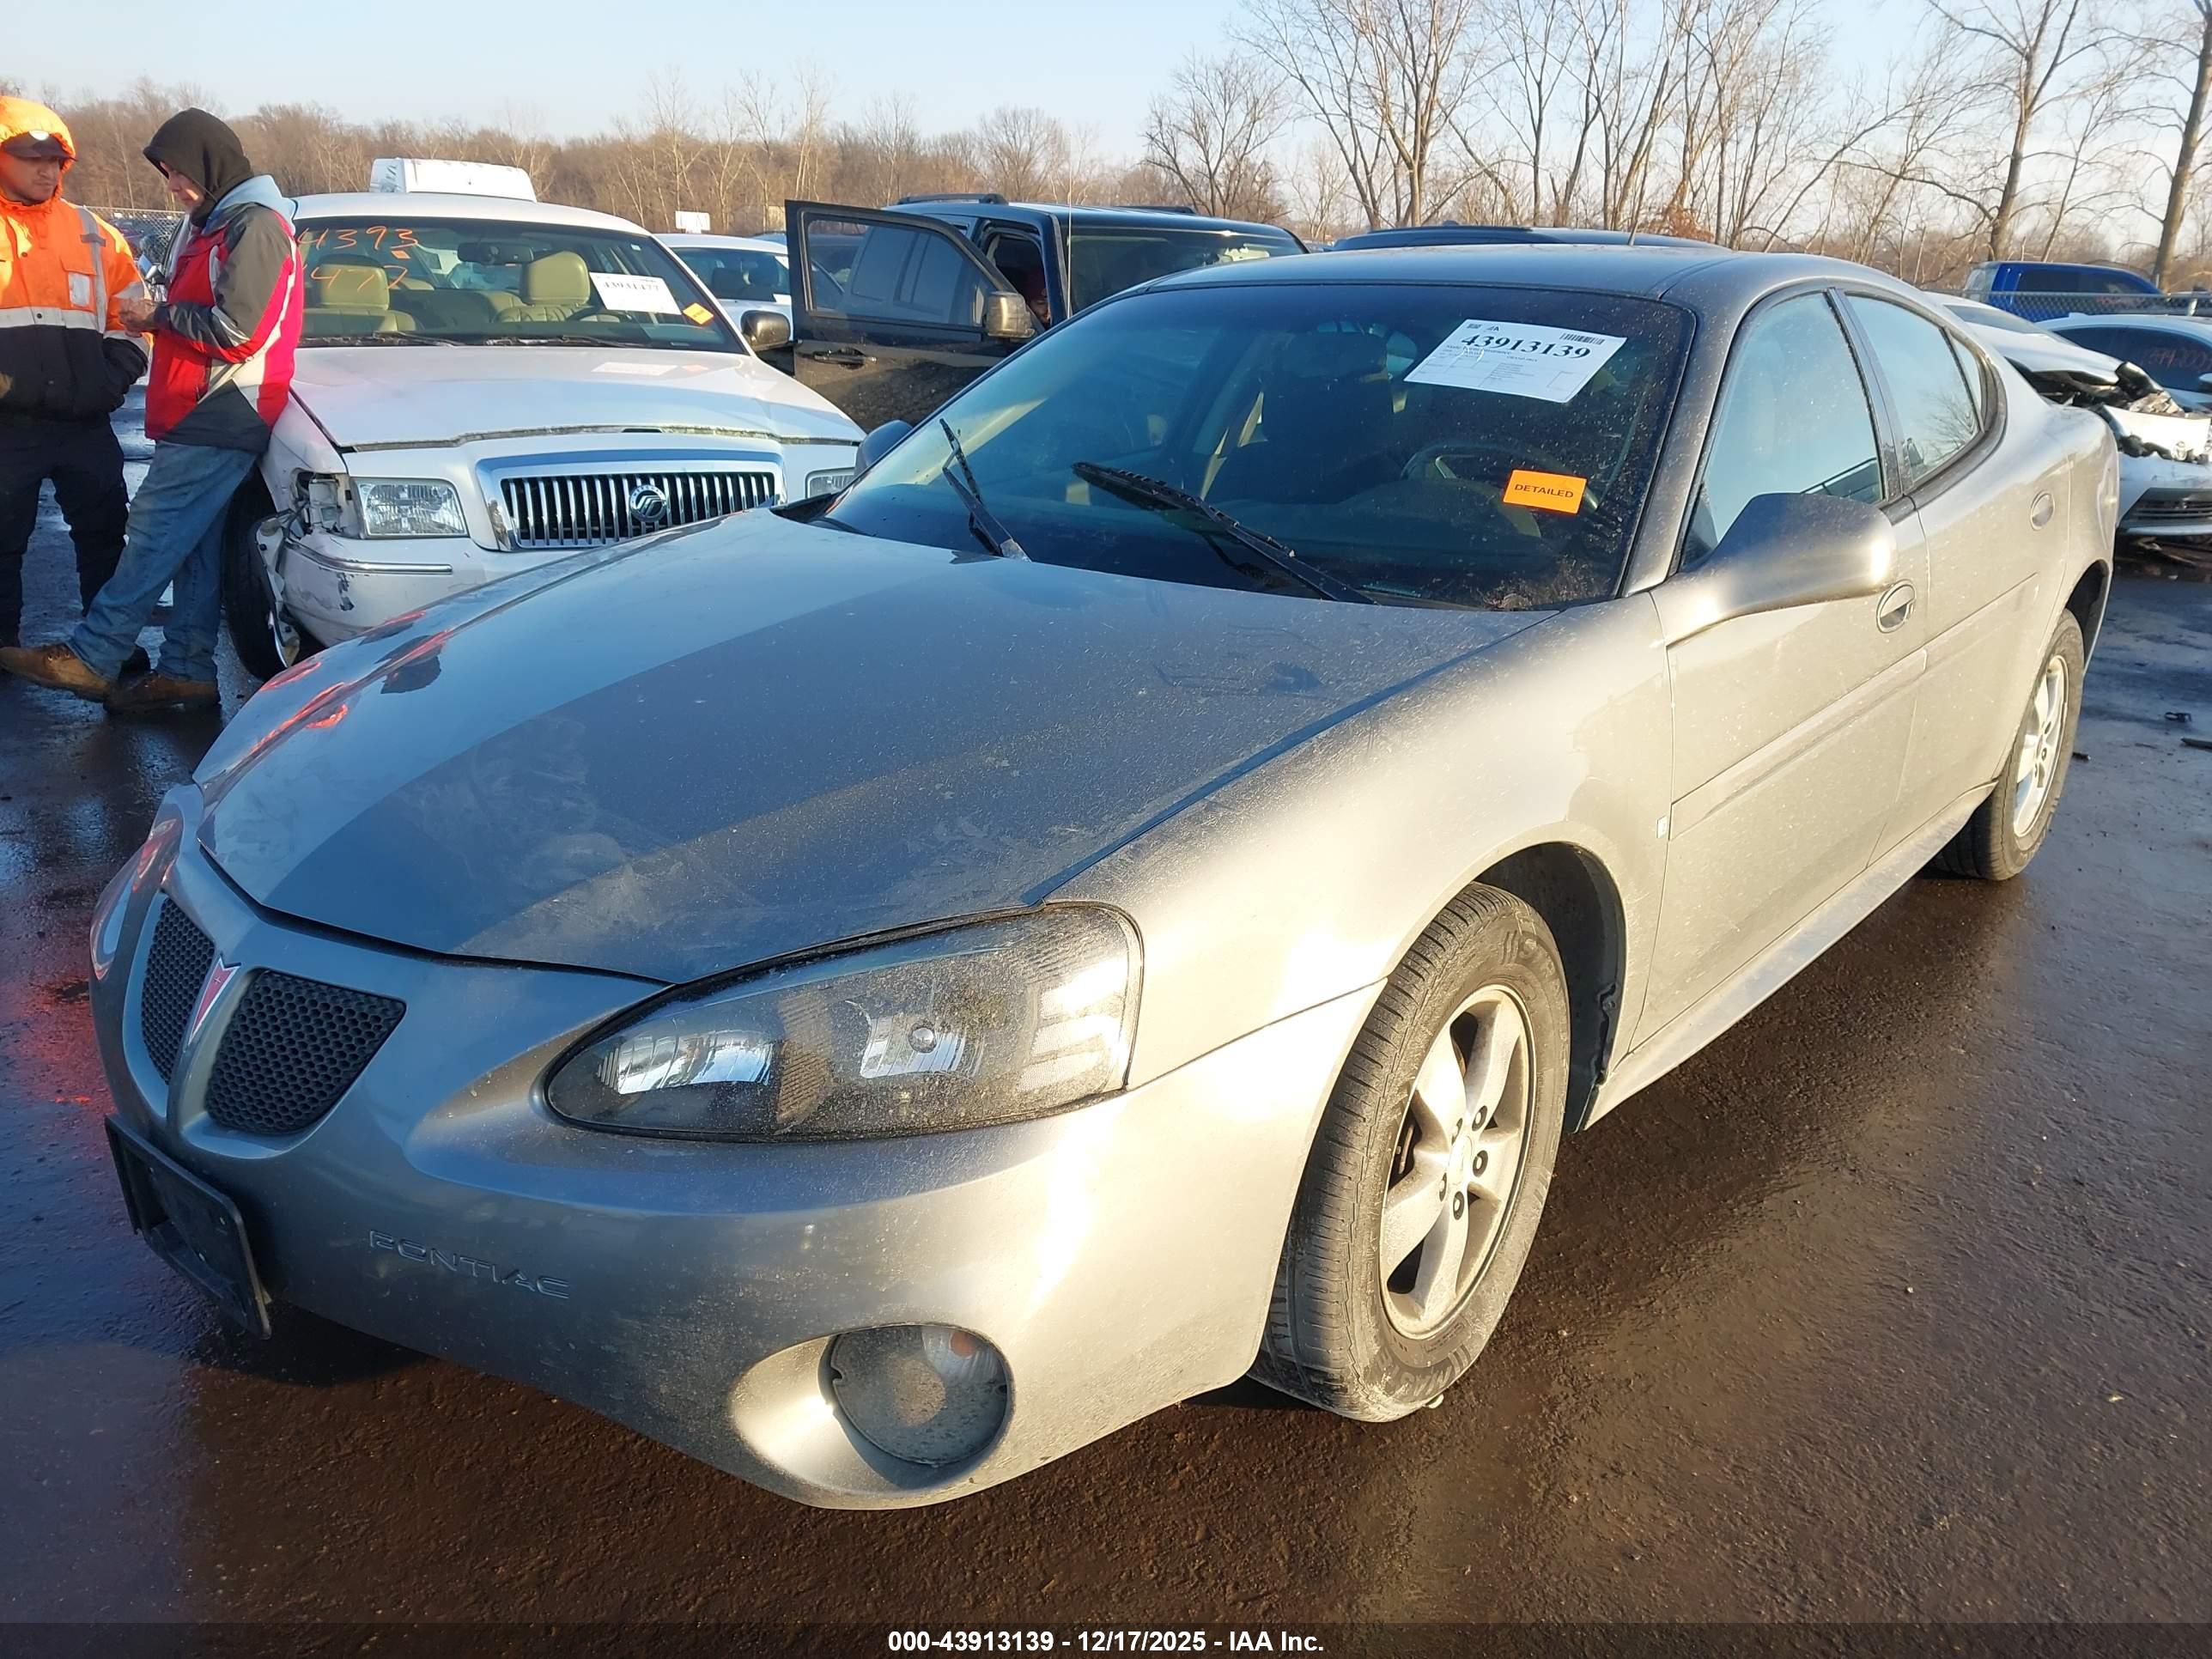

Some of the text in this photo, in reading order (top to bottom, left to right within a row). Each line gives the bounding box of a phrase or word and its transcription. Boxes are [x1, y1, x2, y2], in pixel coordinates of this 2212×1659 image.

[297, 226, 419, 251] 4393
[1462, 335, 1591, 359] 43913139
[1514, 483, 1574, 499] DETAILED
[368, 1229, 570, 1300] PONTIAC
